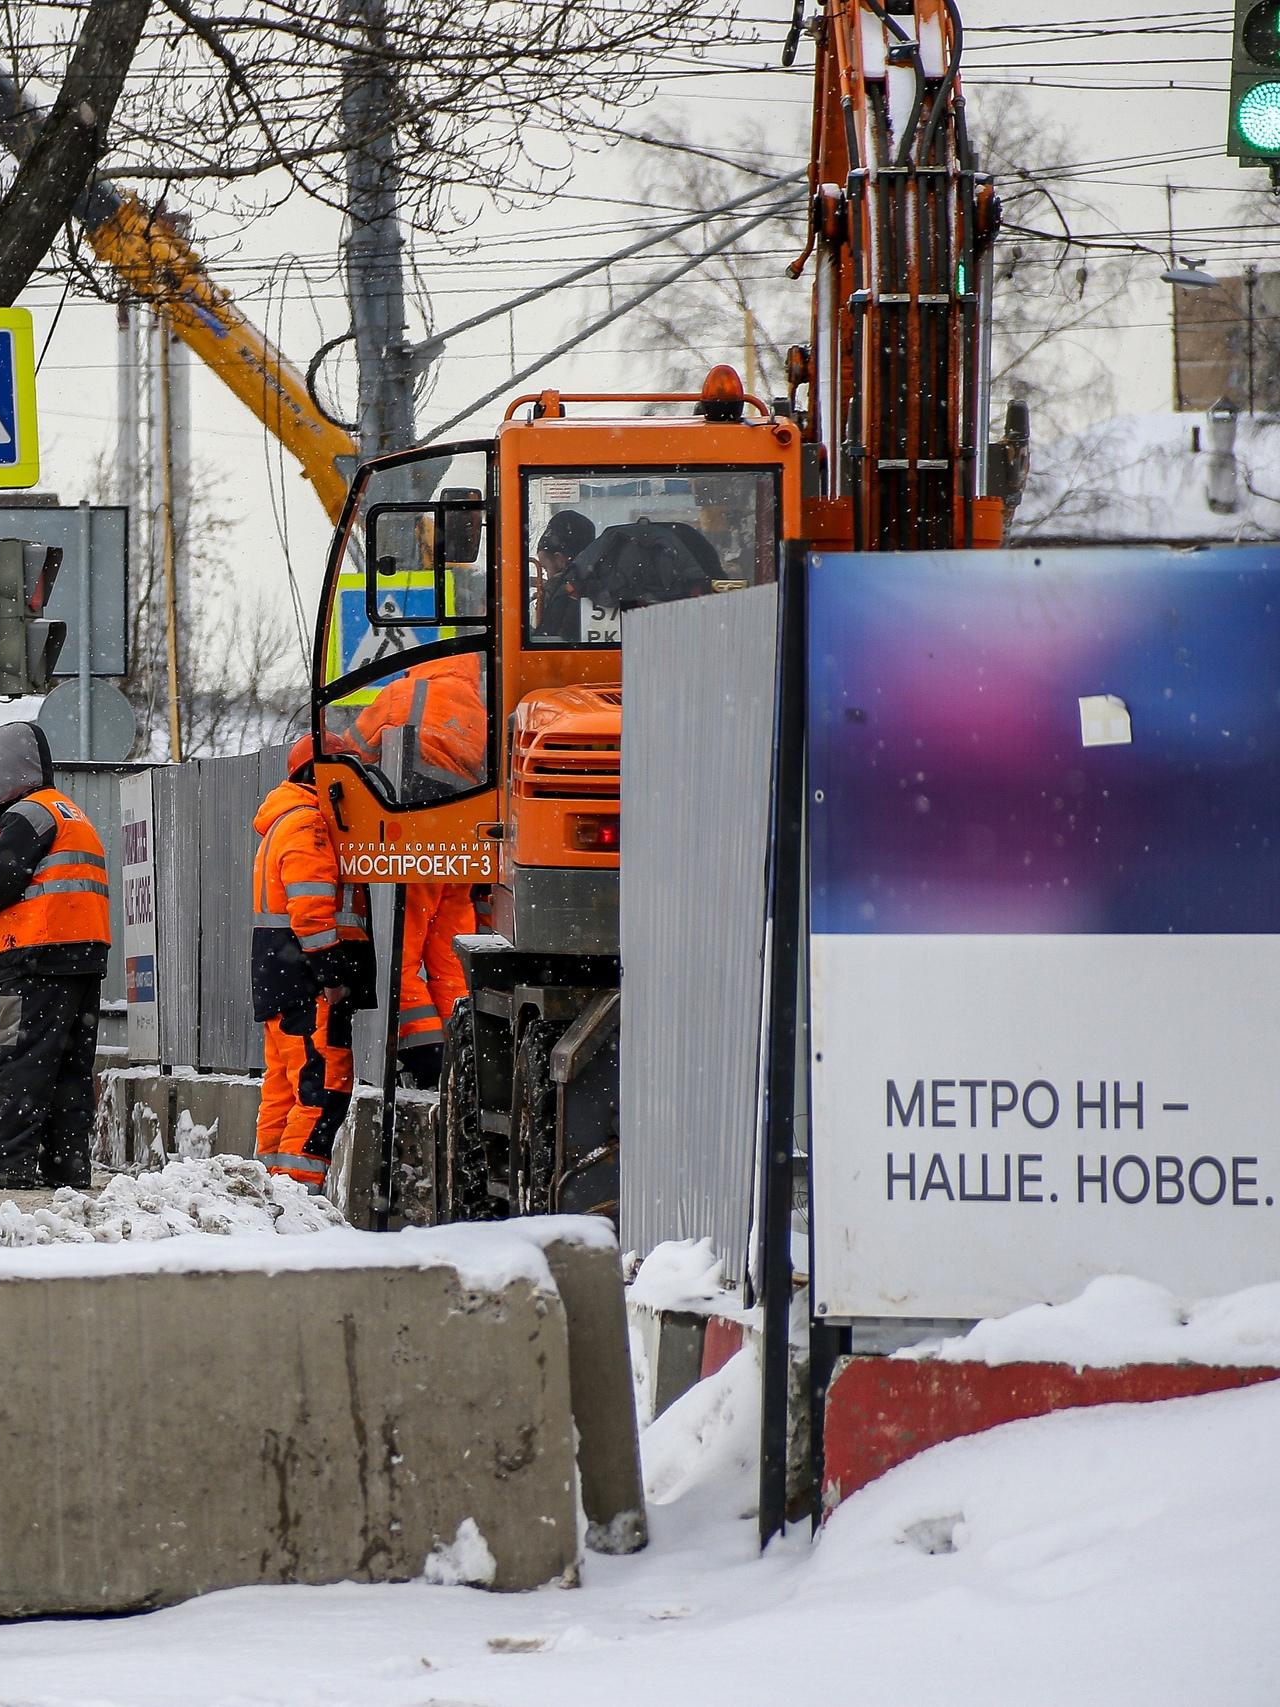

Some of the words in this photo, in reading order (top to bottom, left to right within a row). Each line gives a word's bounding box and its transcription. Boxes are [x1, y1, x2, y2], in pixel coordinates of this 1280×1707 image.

[339, 842, 397, 852] ГРУППА
[405, 841, 492, 852] КОМПАНИЙ
[339, 854, 492, 876] МОСПРОЕКТ-3
[886, 1078, 1060, 1130] МЕТРО
[1076, 1079, 1144, 1130] НН
[886, 1151, 1059, 1203] НАШЕ.
[1076, 1153, 1275, 1207] НОВОЕ.
